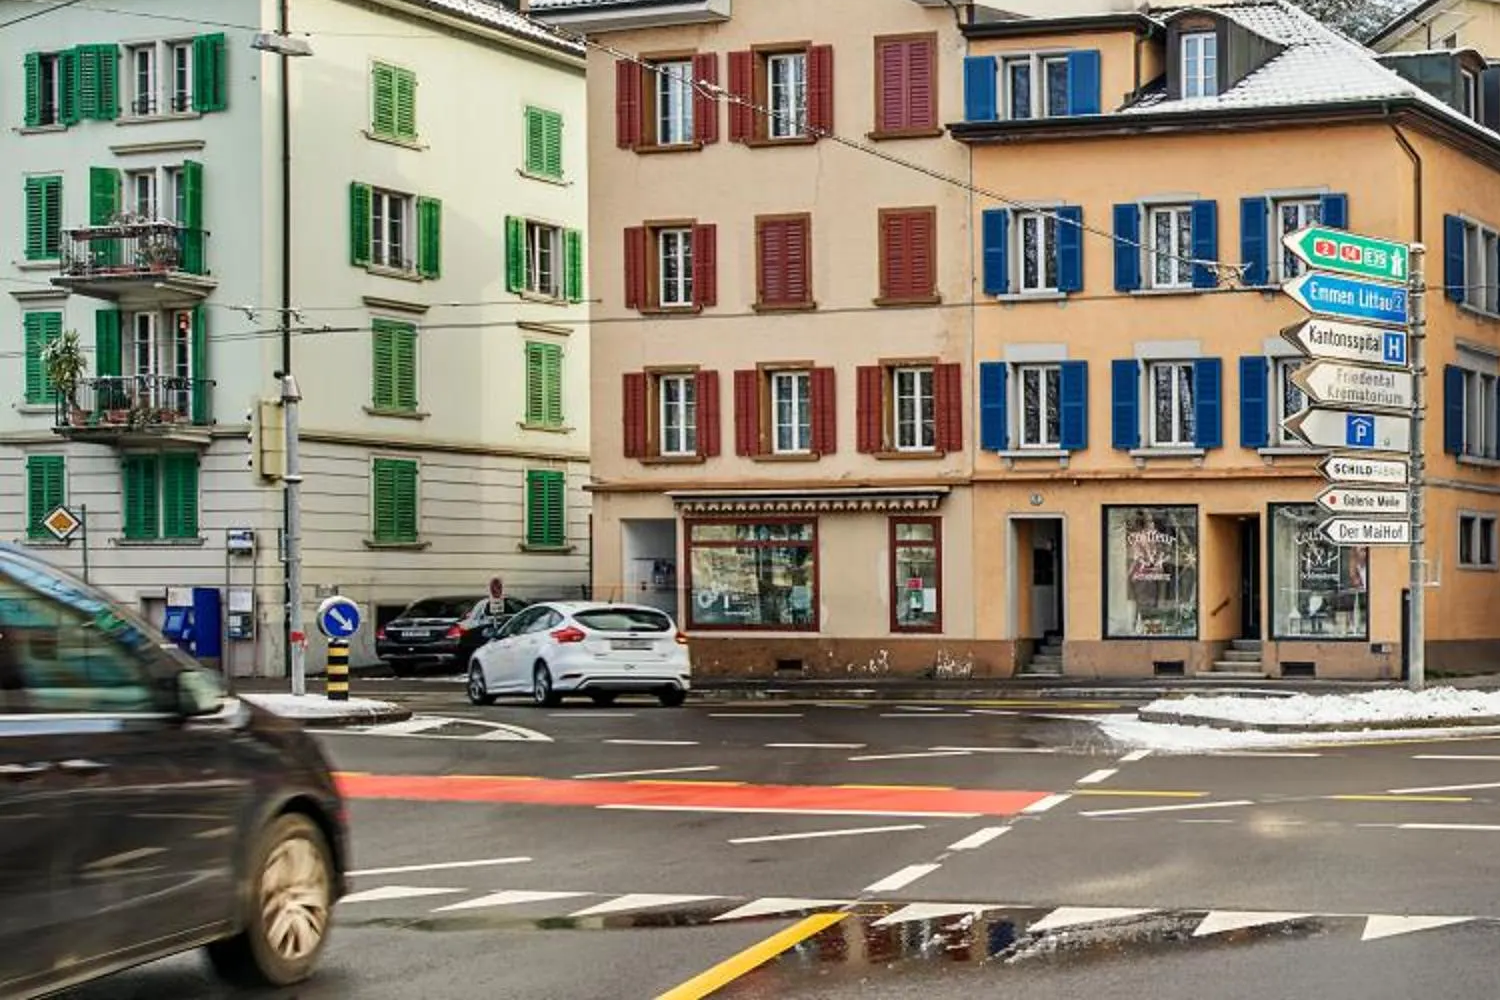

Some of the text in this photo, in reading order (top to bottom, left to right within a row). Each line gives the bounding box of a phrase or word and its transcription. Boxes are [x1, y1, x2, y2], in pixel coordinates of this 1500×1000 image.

[1345, 246, 1357, 259] 14
[1310, 281, 1354, 307] Emmen
[1359, 289, 1393, 311] Littau
[1309, 325, 1400, 359] Kantonsspital H
[1336, 367, 1395, 387] Friedental
[1327, 385, 1403, 404] Krematorium
[1356, 424, 1367, 442] P
[1343, 494, 1375, 506] Galerie
[1340, 524, 1360, 538] Der
[1363, 525, 1403, 540] MaiHof
